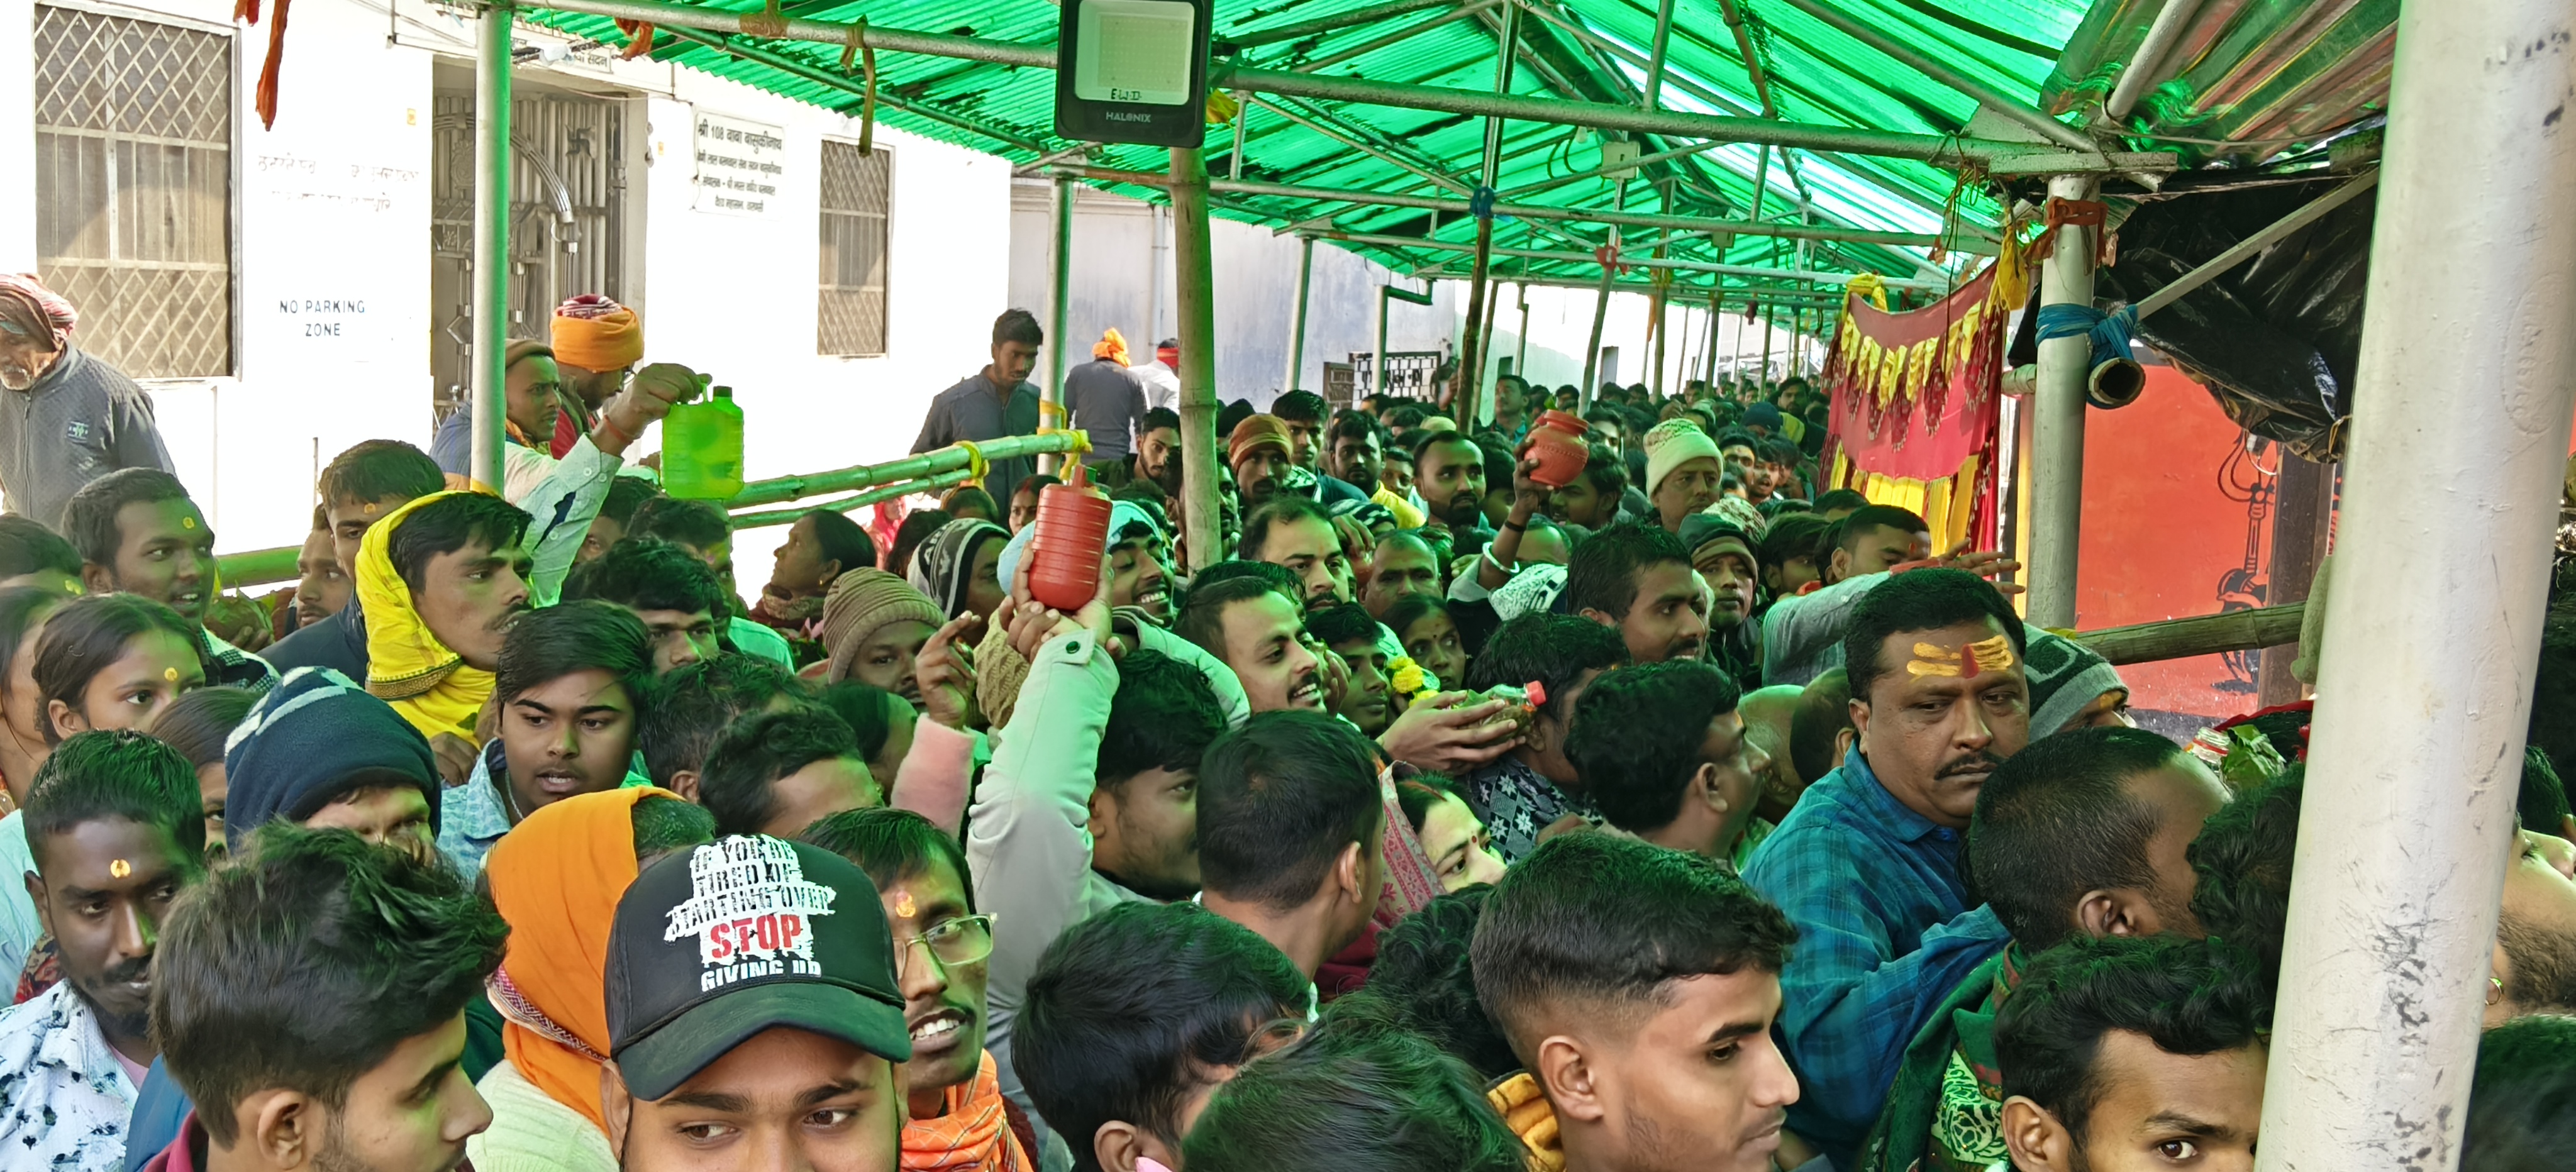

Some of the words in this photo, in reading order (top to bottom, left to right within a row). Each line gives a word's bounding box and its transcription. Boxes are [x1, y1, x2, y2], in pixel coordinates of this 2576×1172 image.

[697, 119, 709, 138] श्री
[711, 126, 724, 140] 108
[1106, 111, 1152, 123] HALONIX
[280, 299, 299, 314] NO
[305, 299, 365, 314] PARKING
[305, 323, 341, 337] ZONE
[696, 864, 759, 897] TIRED
[765, 862, 792, 883] OF
[671, 887, 772, 935] STARTING
[780, 886, 830, 910] OVER
[710, 914, 801, 959] STOP
[701, 959, 784, 993] GIVING
